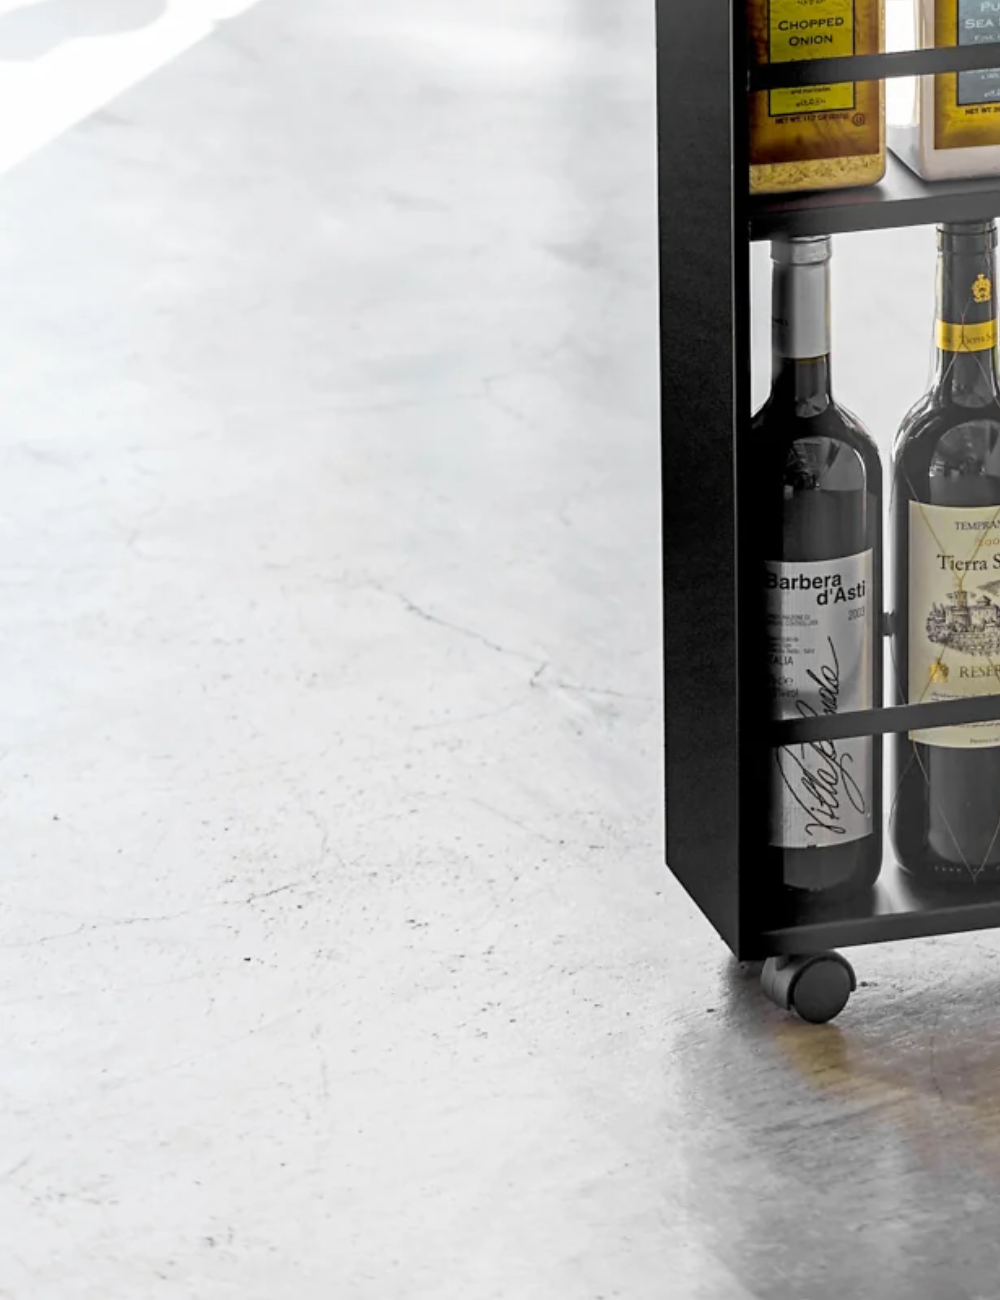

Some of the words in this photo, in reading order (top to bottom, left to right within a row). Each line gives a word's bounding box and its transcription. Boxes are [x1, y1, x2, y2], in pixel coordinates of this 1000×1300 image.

[778, 16, 844, 32] CHOPPED
[964, 18, 994, 30] SEA
[788, 34, 833, 47] ONION
[936, 553, 988, 571] Tierra
[766, 573, 842, 591] Barbera
[816, 580, 866, 607] d'Asti
